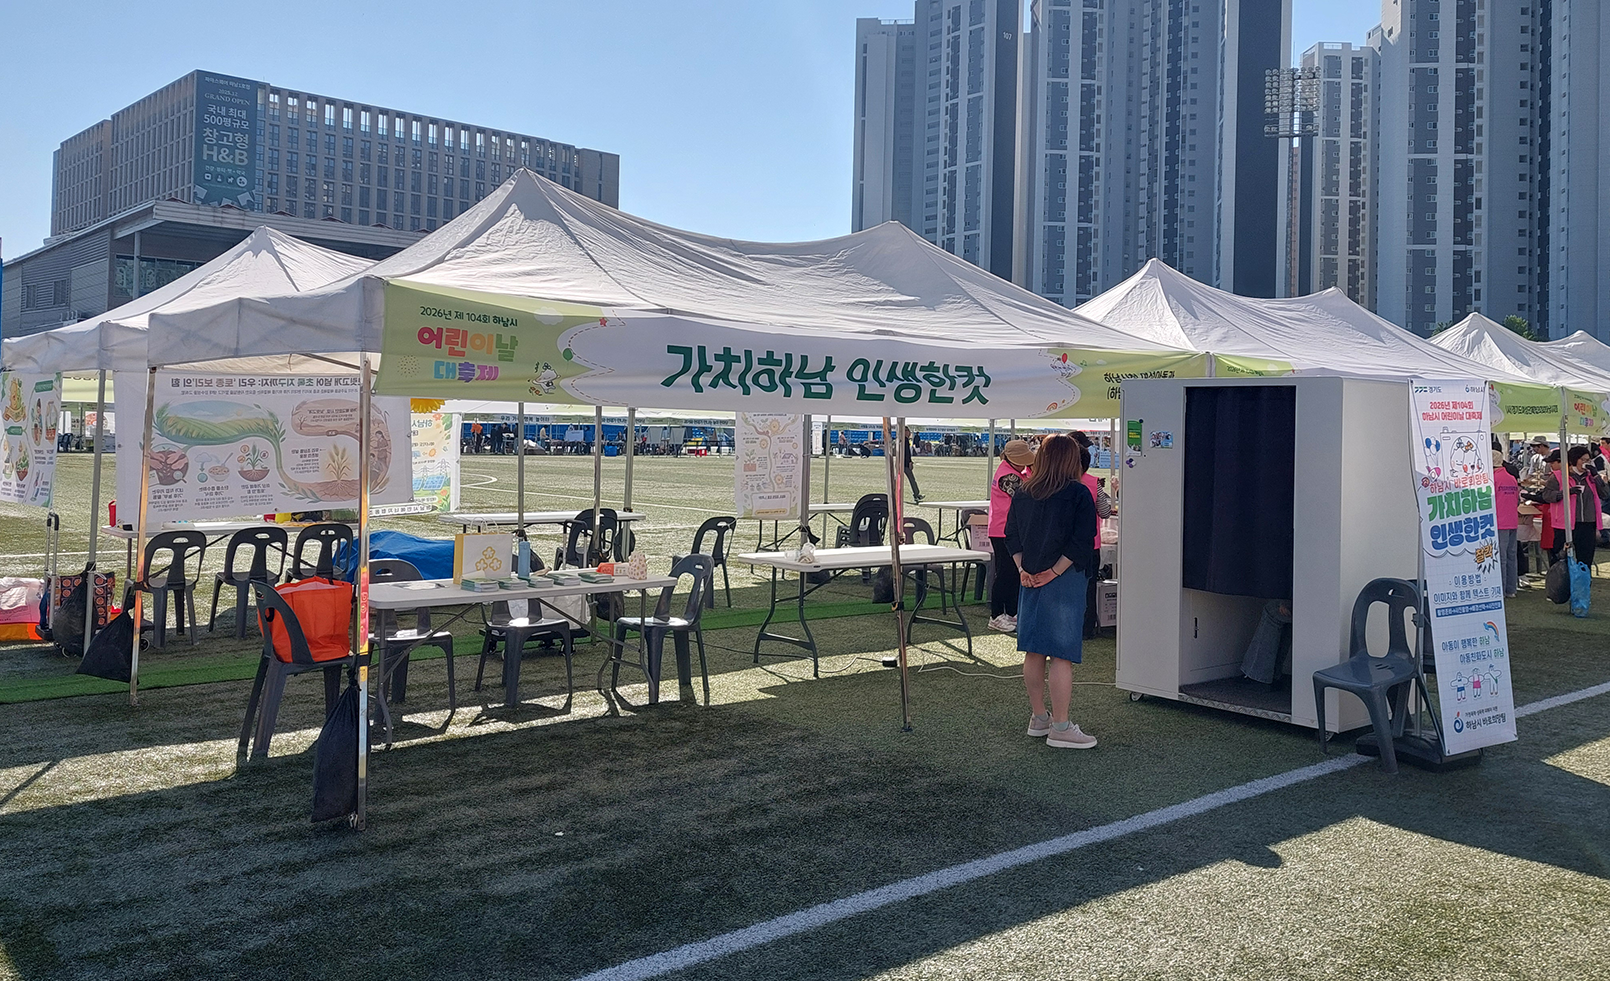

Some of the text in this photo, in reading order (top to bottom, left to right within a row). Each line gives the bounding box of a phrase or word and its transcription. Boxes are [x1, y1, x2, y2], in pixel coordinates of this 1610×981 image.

[1003, 31, 1013, 40] 107
[204, 93, 250, 106] GRAND OPEN
[207, 104, 247, 120] 국내 최대
[203, 114, 249, 130] 500평규모
[203, 127, 249, 150] 창고형
[202, 144, 249, 166] H&B
[420, 306, 519, 327] 2026년 제 104회 하남시
[417, 326, 519, 362] 어린이날
[433, 360, 500, 383] 대축제
[660, 344, 992, 405] 가치하남 인생한컷
[1429, 401, 1451, 410] 2026년
[1422, 411, 1440, 421] 하남시
[1440, 411, 1465, 421] 어린이날
[1430, 472, 1489, 494] 하남시 바로희망팀
[1427, 485, 1493, 522] 가치하남
[1430, 513, 1496, 550] 인생한컷
[1453, 574, 1482, 586] 이용방법
[1433, 591, 1458, 602] 이미지와
[1459, 589, 1472, 600] 함께
[1472, 587, 1489, 598] 텍스트
[1441, 635, 1490, 652] 아동이 행복한 하남
[1459, 647, 1505, 663] 아동친화도시 하남
[1465, 712, 1506, 730] 하남시 바로희망팀
